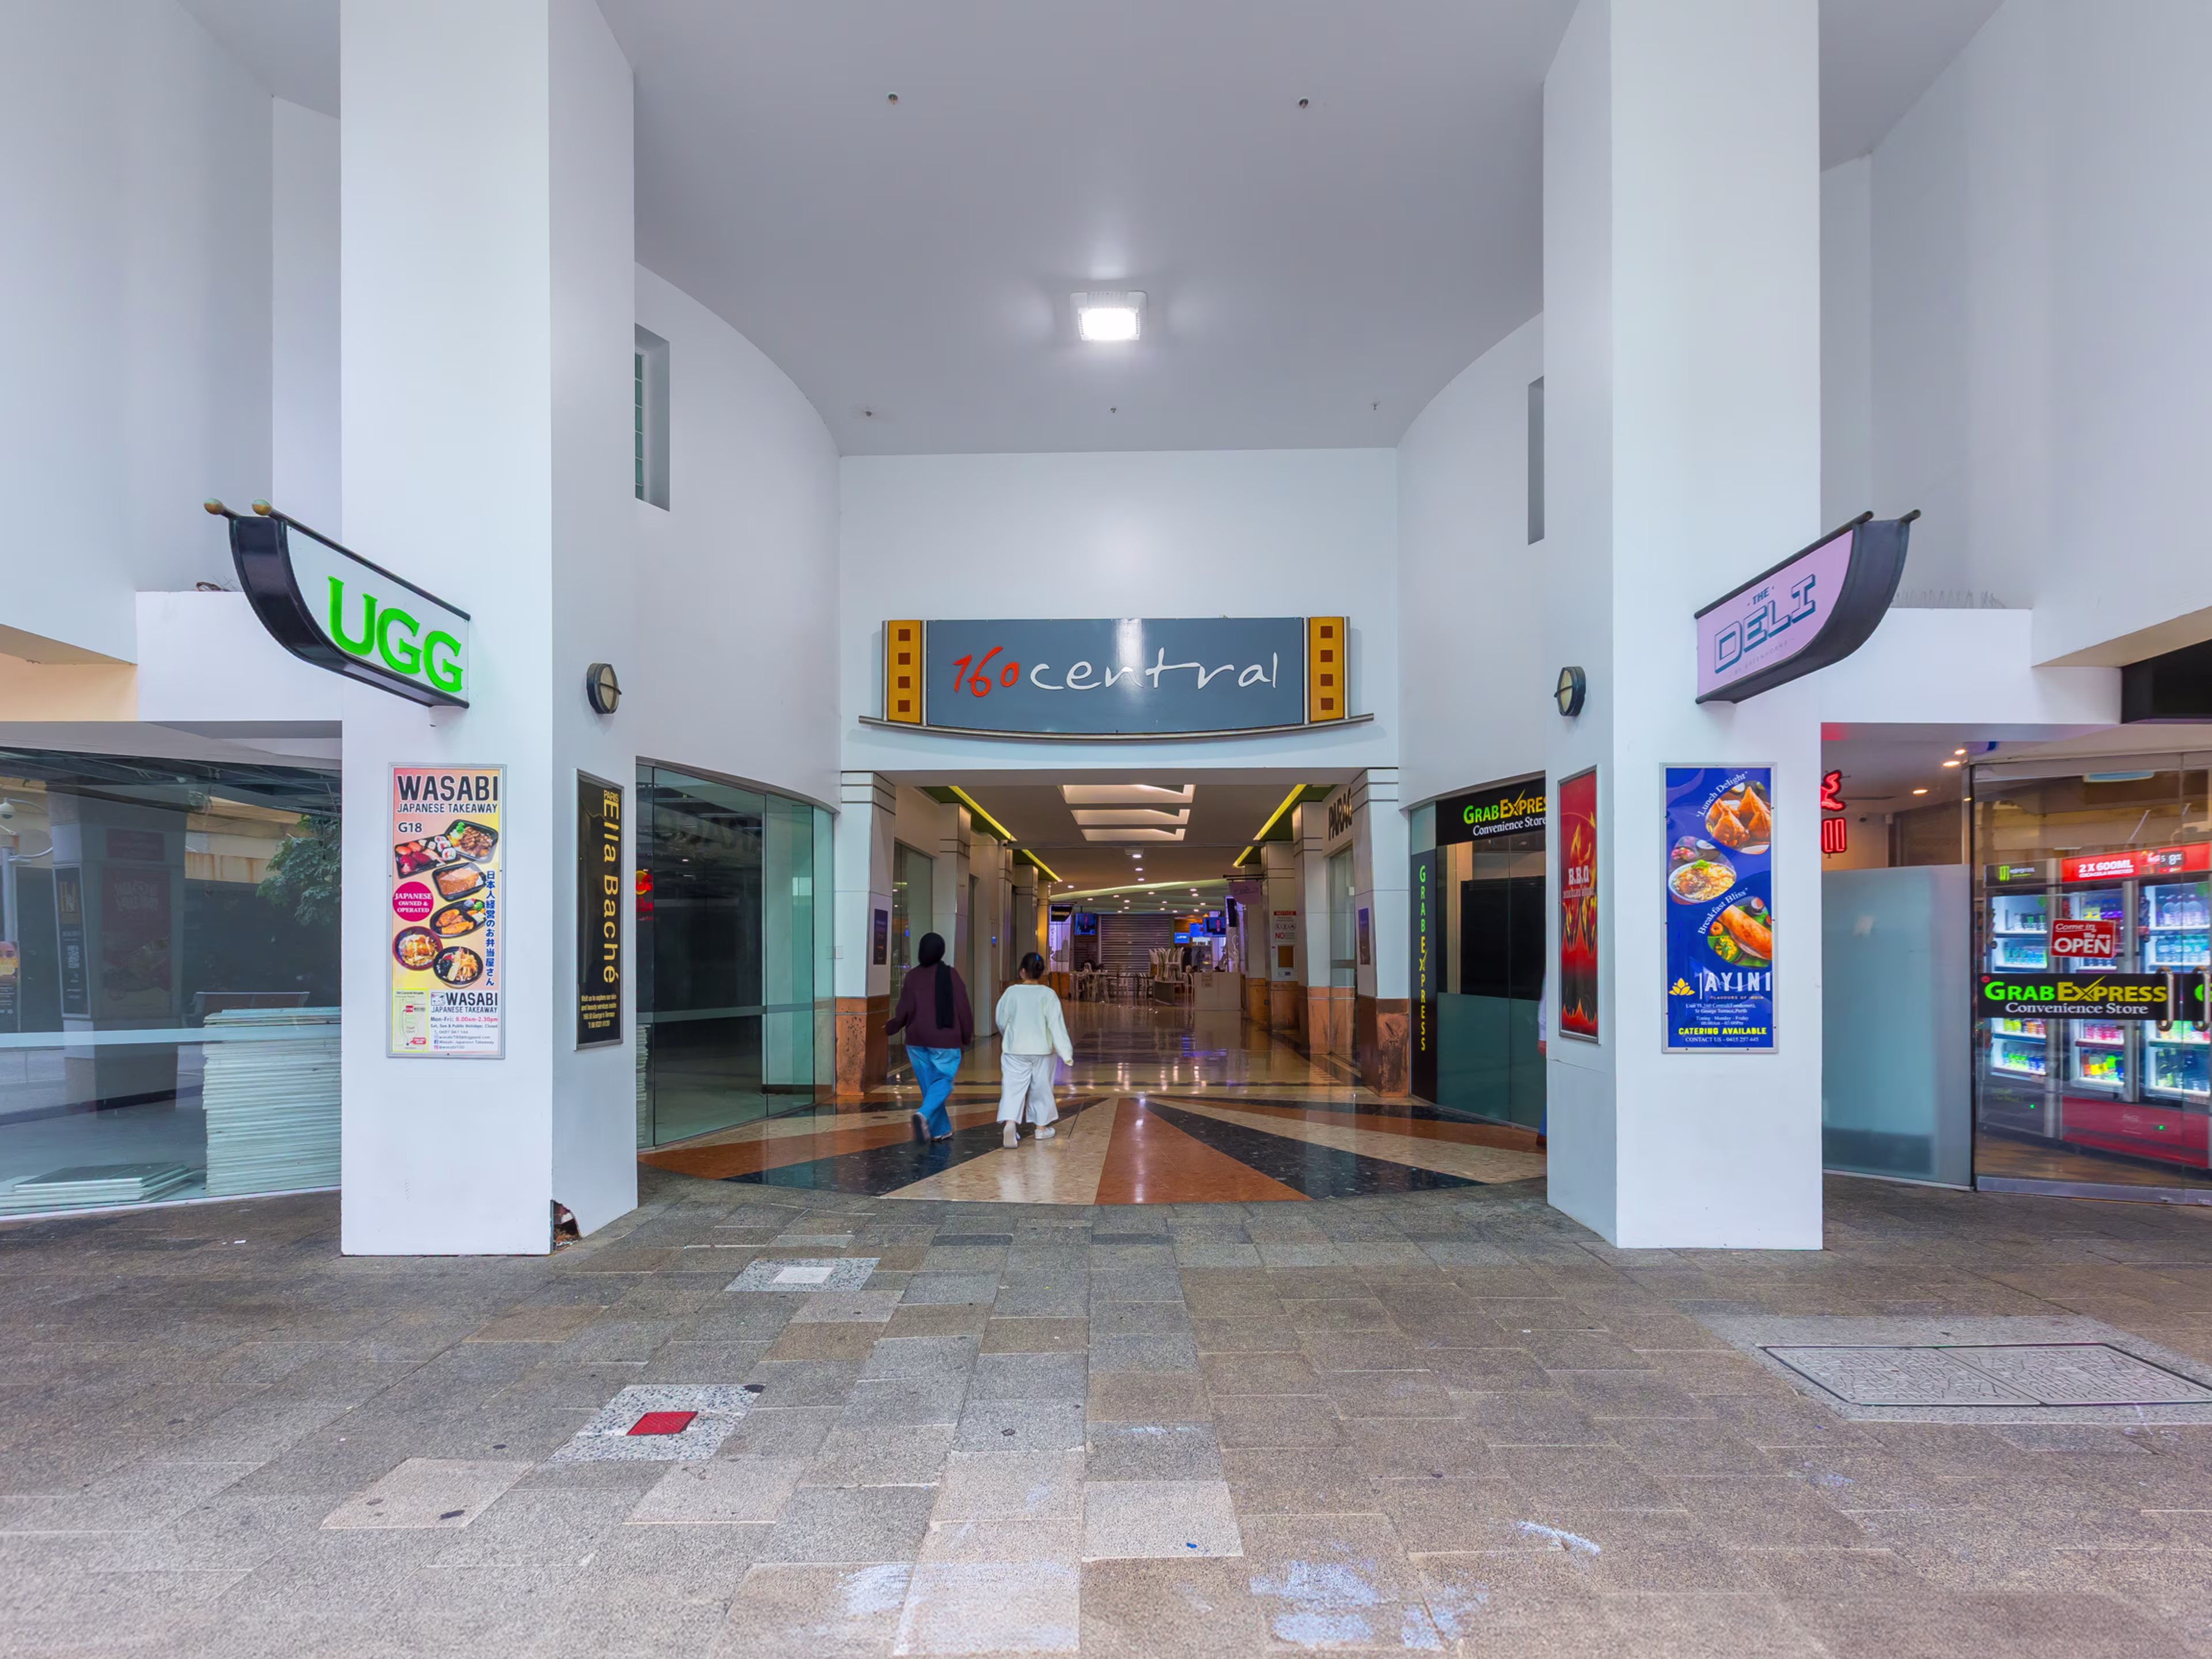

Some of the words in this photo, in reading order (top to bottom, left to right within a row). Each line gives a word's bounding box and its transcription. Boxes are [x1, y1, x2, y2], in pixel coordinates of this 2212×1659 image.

[1752, 586, 1770, 606] THE
[328, 575, 463, 692] UGG
[1714, 574, 1816, 674] DELI
[953, 646, 1020, 698] 160
[1029, 647, 1278, 691] central
[397, 775, 498, 801] WASABI
[604, 790, 618, 802] PARIS
[397, 803, 445, 813] JAPANESE
[449, 803, 498, 813] TAKEAWAY
[398, 822, 422, 833] G18
[604, 800, 619, 862] Ella
[1473, 820, 1524, 836] Convenience
[2096, 859, 2134, 871] 600ML
[1698, 902, 1726, 934] Breakfast
[485, 870, 495, 986] 日本人経営のお弁当屋さん
[603, 874, 619, 983] Baché
[2054, 937, 2111, 954] OPEN
[1705, 972, 1771, 991] AYINI
[445, 992, 498, 1006] WASABI
[2005, 1002, 2103, 1014] Convenience
[2105, 1002, 2149, 1014] Store
[1678, 1027, 1718, 1035] CATERING
[1722, 1027, 1767, 1035] AVAILABLE
